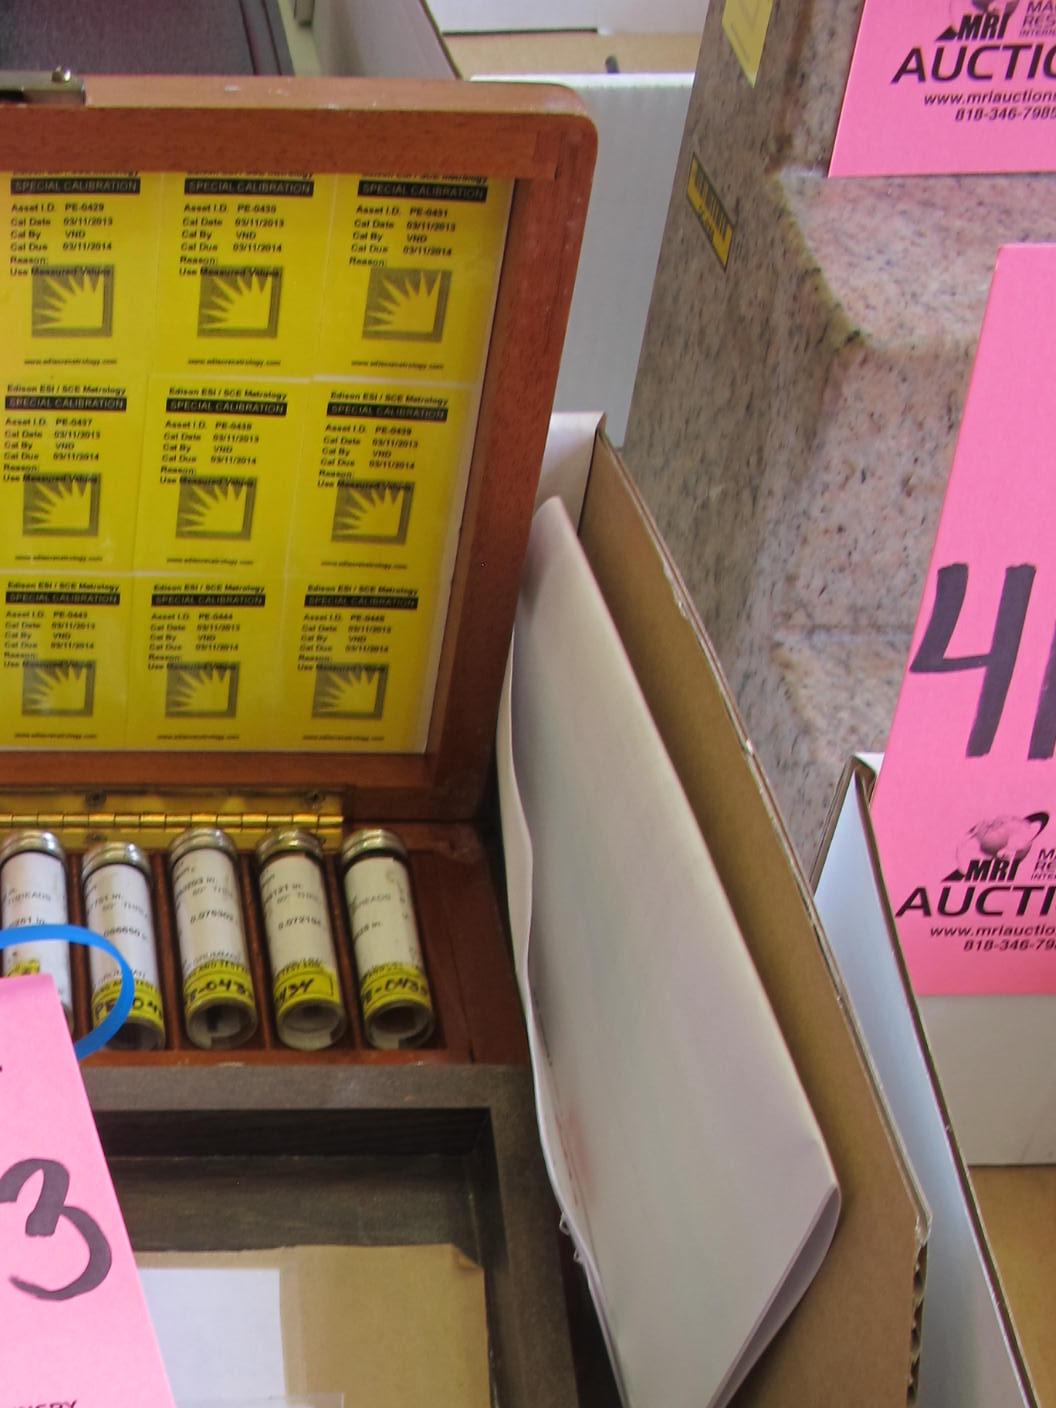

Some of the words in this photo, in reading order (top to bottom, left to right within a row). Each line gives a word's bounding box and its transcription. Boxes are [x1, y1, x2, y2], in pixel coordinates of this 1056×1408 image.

[956, 13, 1011, 40] MRI
[83, 385, 127, 396] Metrology
[965, 858, 1021, 882] MRI
[963, 938, 1056, 952] 818-346-79
